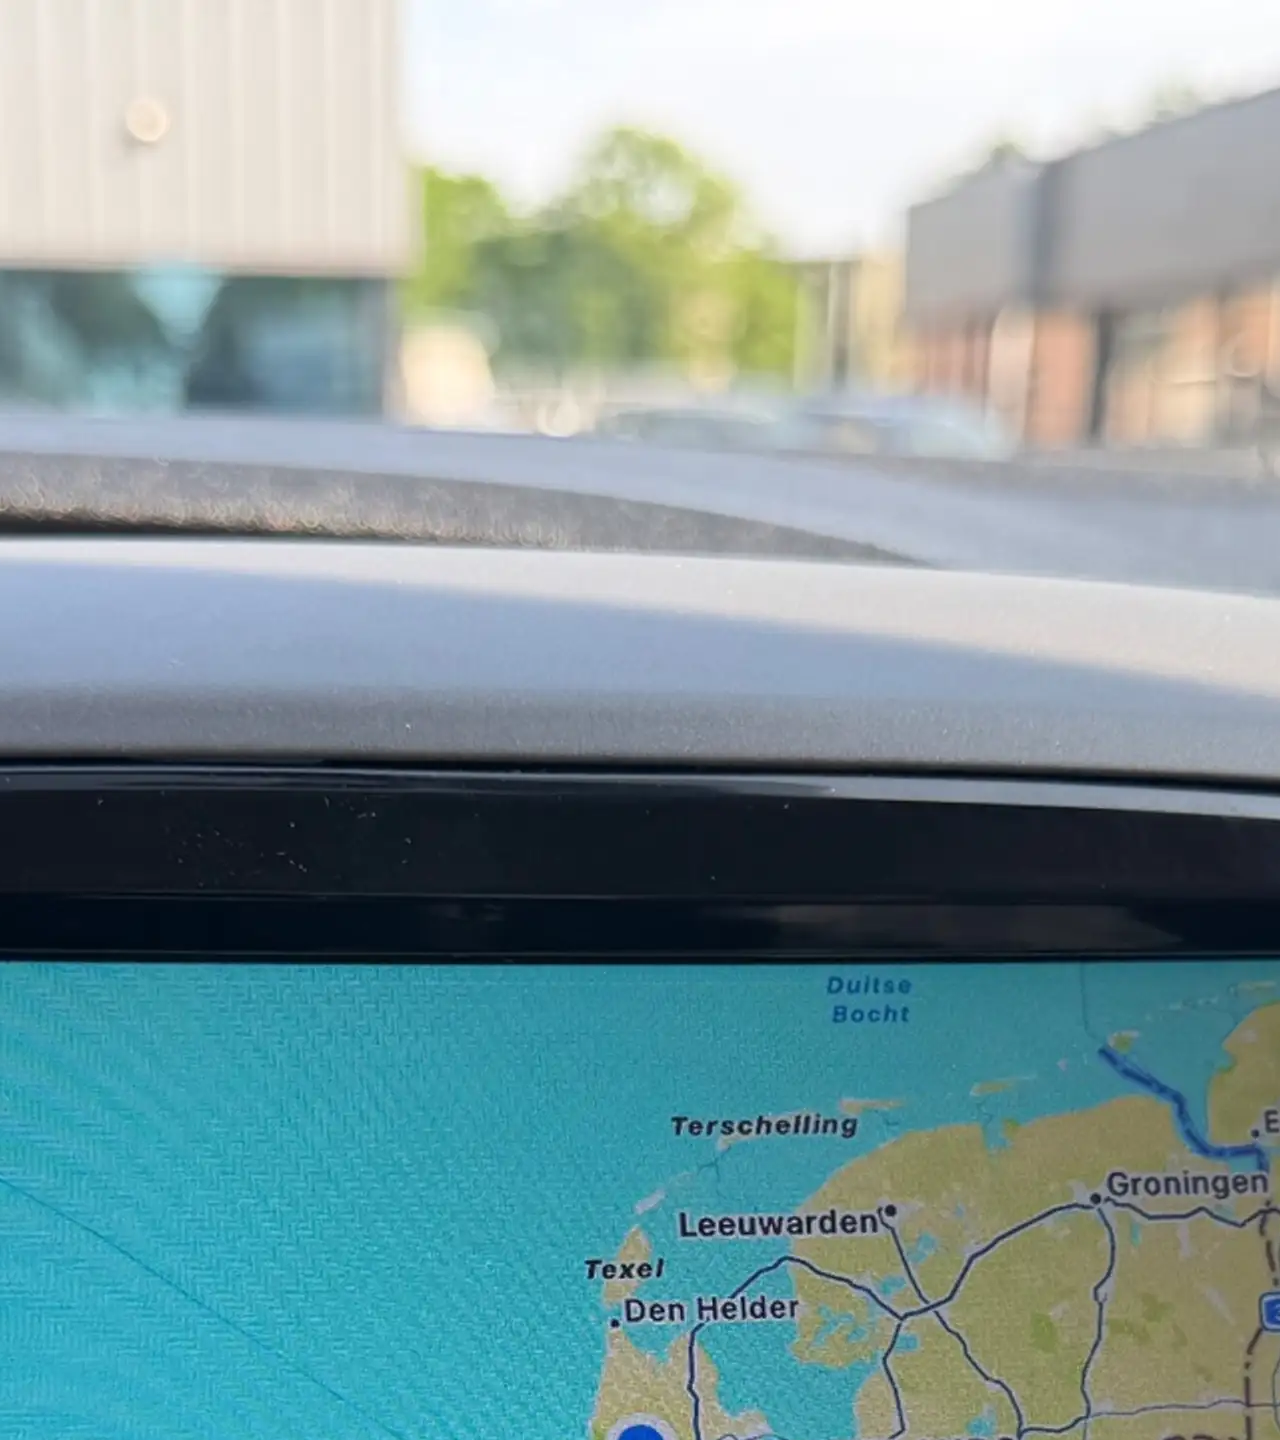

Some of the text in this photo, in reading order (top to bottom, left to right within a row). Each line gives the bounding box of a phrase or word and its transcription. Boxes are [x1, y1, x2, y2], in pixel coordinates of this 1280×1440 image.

[827, 975, 912, 995] Duitse
[832, 1005, 910, 1024] Bocht
[671, 1114, 858, 1138] Terschelling
[1107, 1169, 1269, 1199] Groningen
[679, 1208, 878, 1238] Leeuwarden
[584, 1258, 665, 1280] Texel
[625, 1297, 799, 1323] Den Helder
